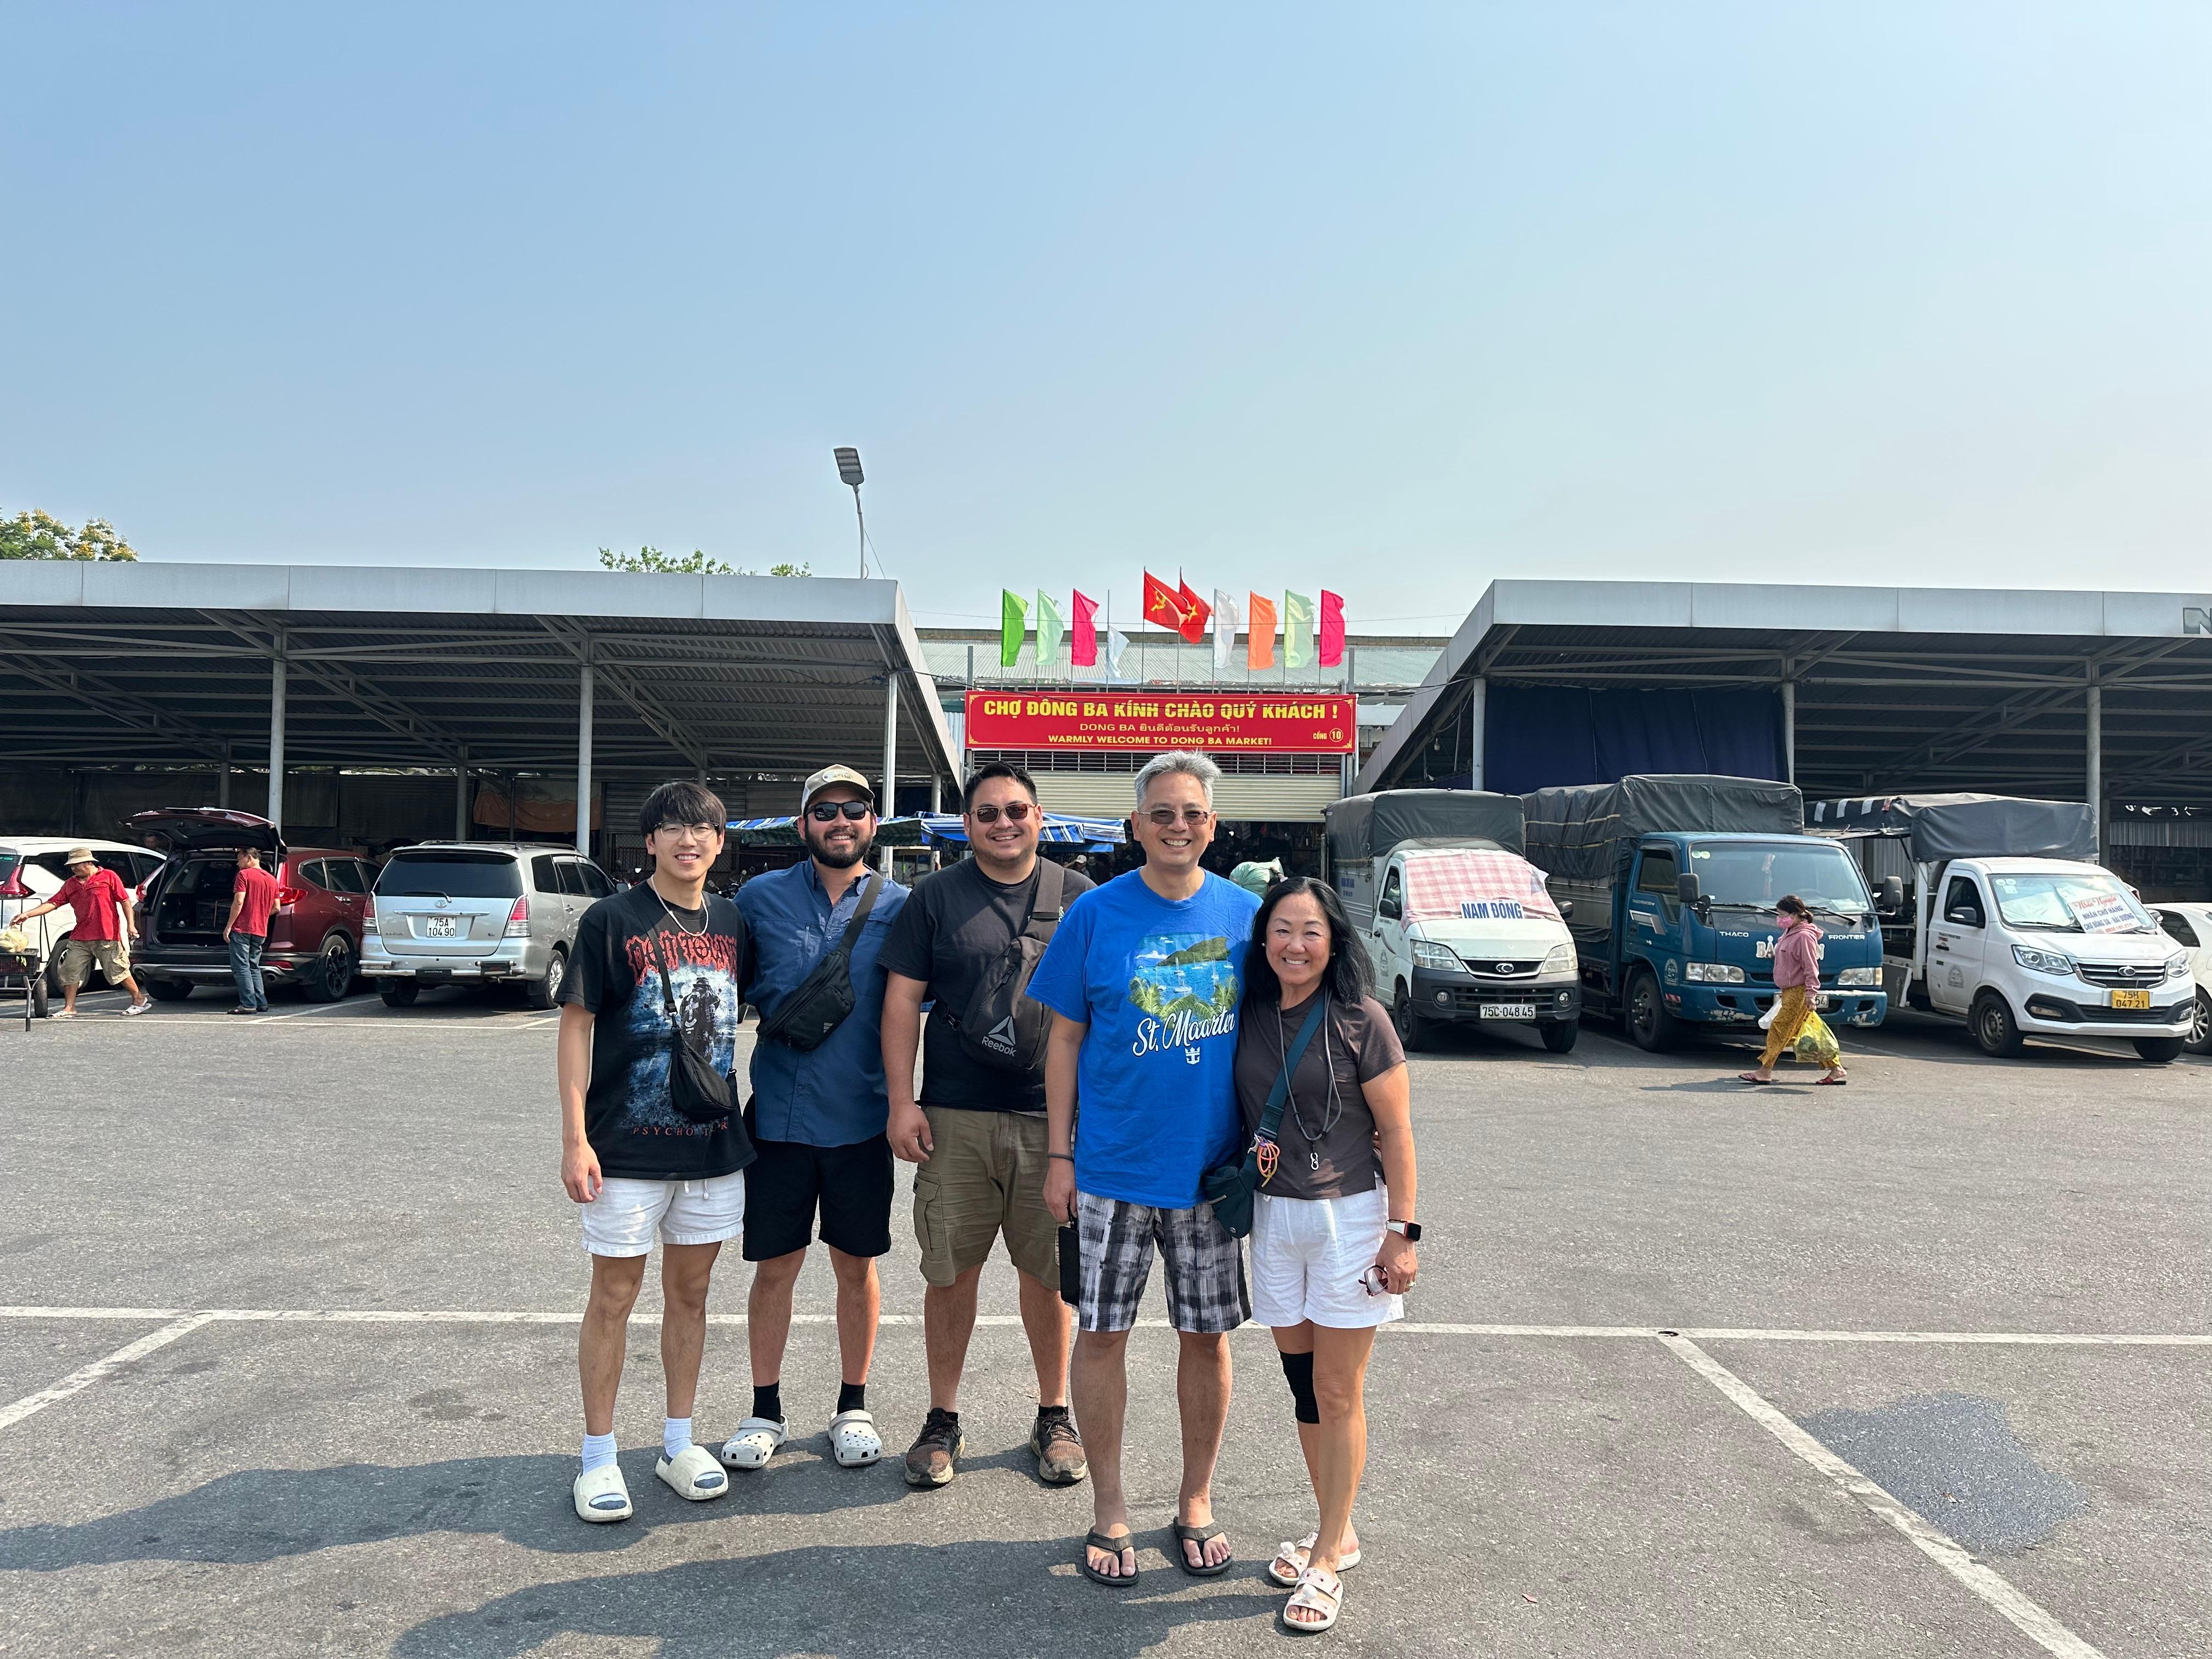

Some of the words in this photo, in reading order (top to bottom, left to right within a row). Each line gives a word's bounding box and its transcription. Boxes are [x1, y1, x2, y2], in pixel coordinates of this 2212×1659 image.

[984, 699, 1022, 719] CHỢ
[1026, 699, 1078, 717] ĐÔNG
[1084, 702, 1109, 717] BA
[1114, 699, 1159, 718] KÍNH
[1165, 700, 1215, 718] CHÀO
[1220, 701, 1257, 720] QUÝ
[1262, 701, 1325, 719] KHÁCH
[1080, 723, 1115, 731] DONG
[1048, 735, 1093, 743] WARMLY
[1097, 736, 1150, 744] WELCOME
[1332, 730, 1342, 740] 10
[1461, 902, 1490, 919] NAM
[1490, 900, 1523, 919] ĐÔNG
[434, 918, 449, 927] 75A
[428, 927, 455, 937] 104.90
[2122, 991, 2139, 999] 75H
[2116, 999, 2145, 1008] 047.21
[1132, 1017, 1161, 1057] St.
[1161, 1005, 1235, 1050] Maarten
[981, 1035, 1017, 1057] Reebok
[633, 1126, 694, 1137] PSYCHO
